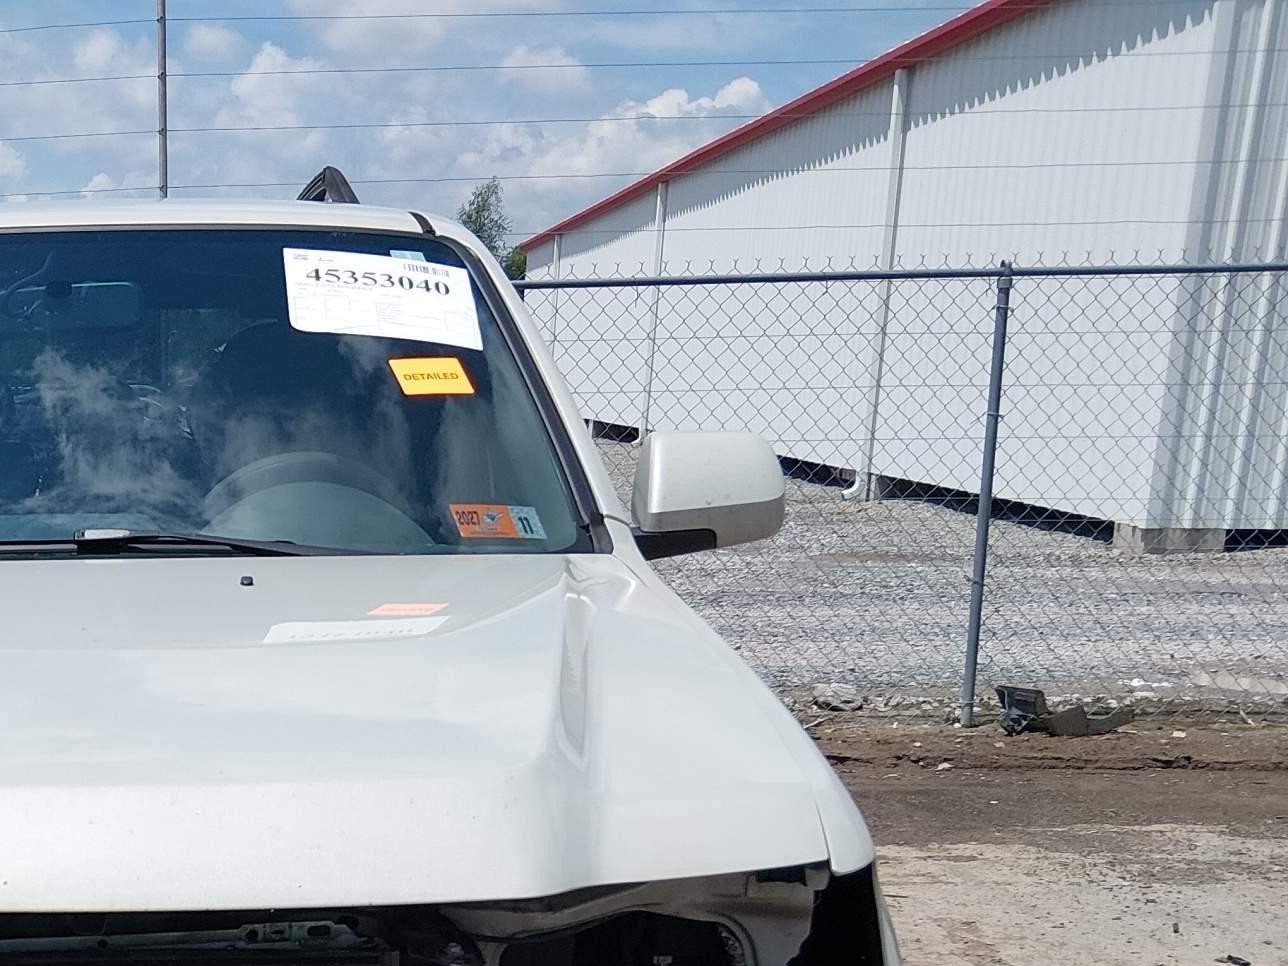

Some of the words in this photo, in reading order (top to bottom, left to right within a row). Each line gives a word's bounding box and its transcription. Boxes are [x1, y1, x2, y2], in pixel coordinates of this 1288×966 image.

[306, 268, 451, 296] 45353040
[402, 372, 459, 382] DETAILED
[455, 511, 481, 527] 2027
